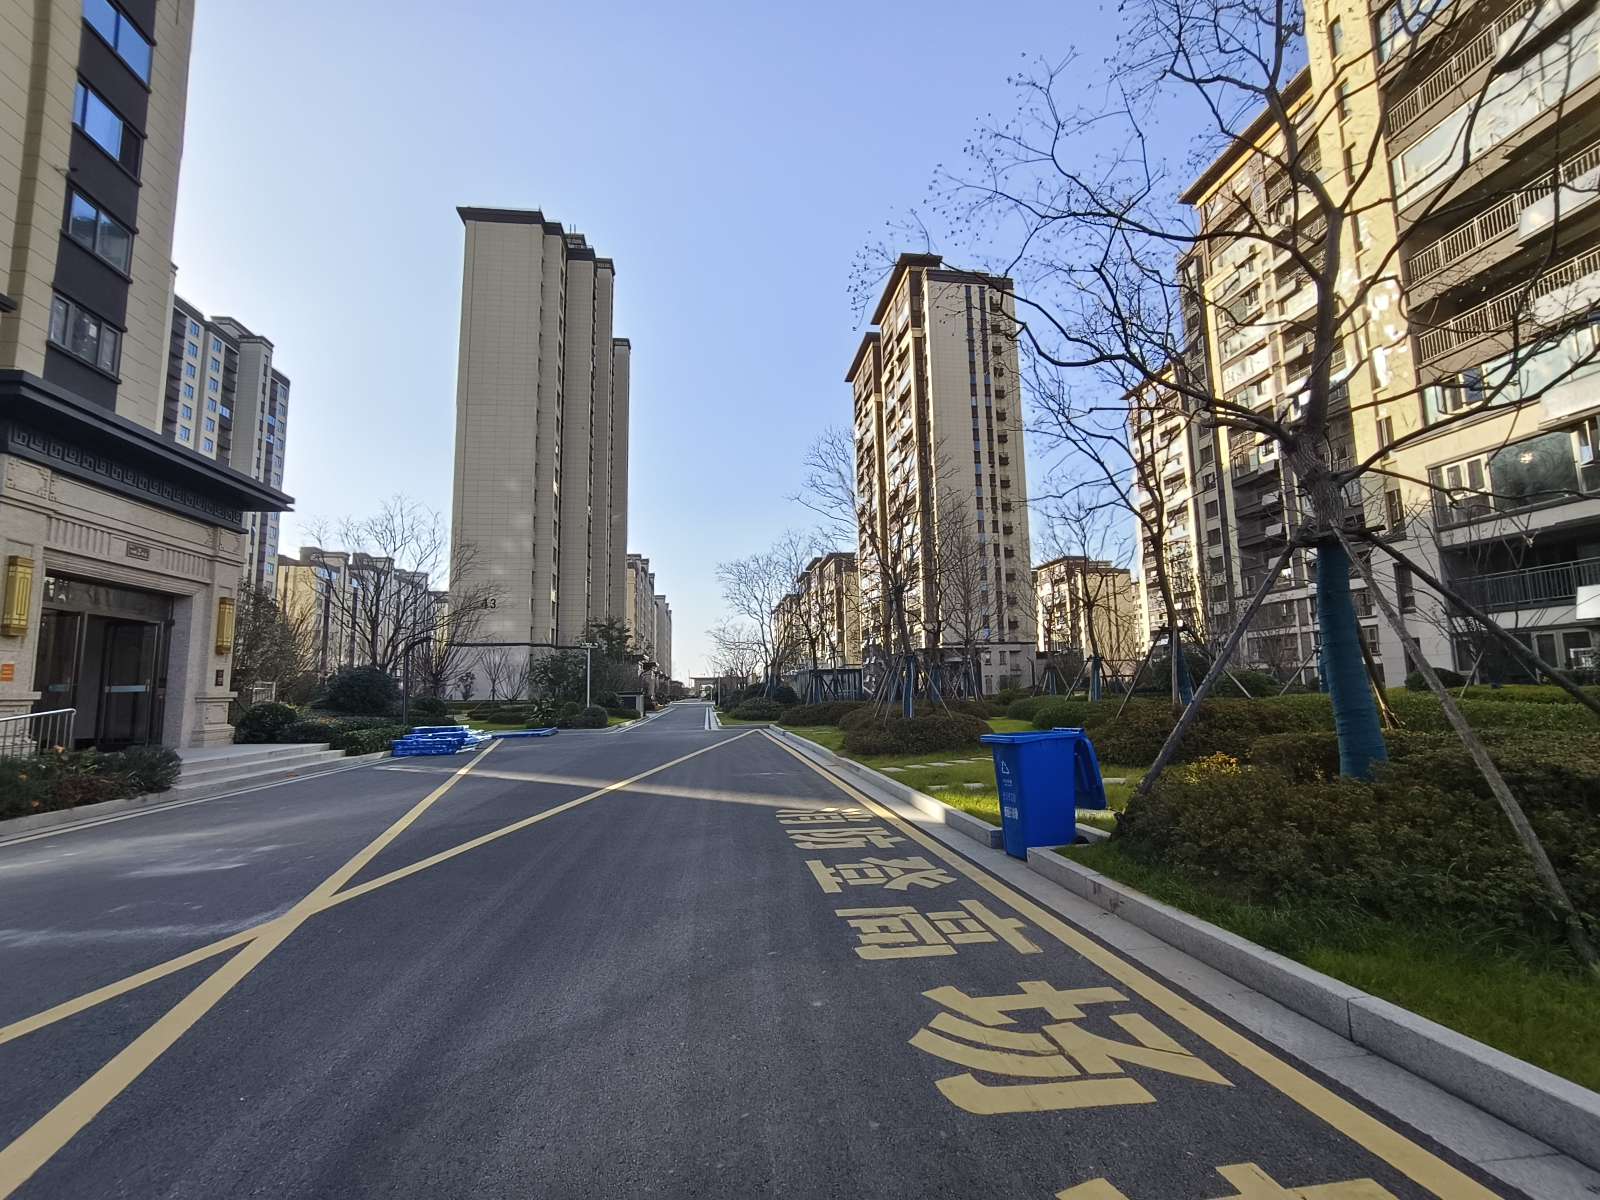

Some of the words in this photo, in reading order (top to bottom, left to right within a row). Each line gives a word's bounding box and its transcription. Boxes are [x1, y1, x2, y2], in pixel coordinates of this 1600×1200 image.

[776, 806, 1401, 1200] 消防登高场
